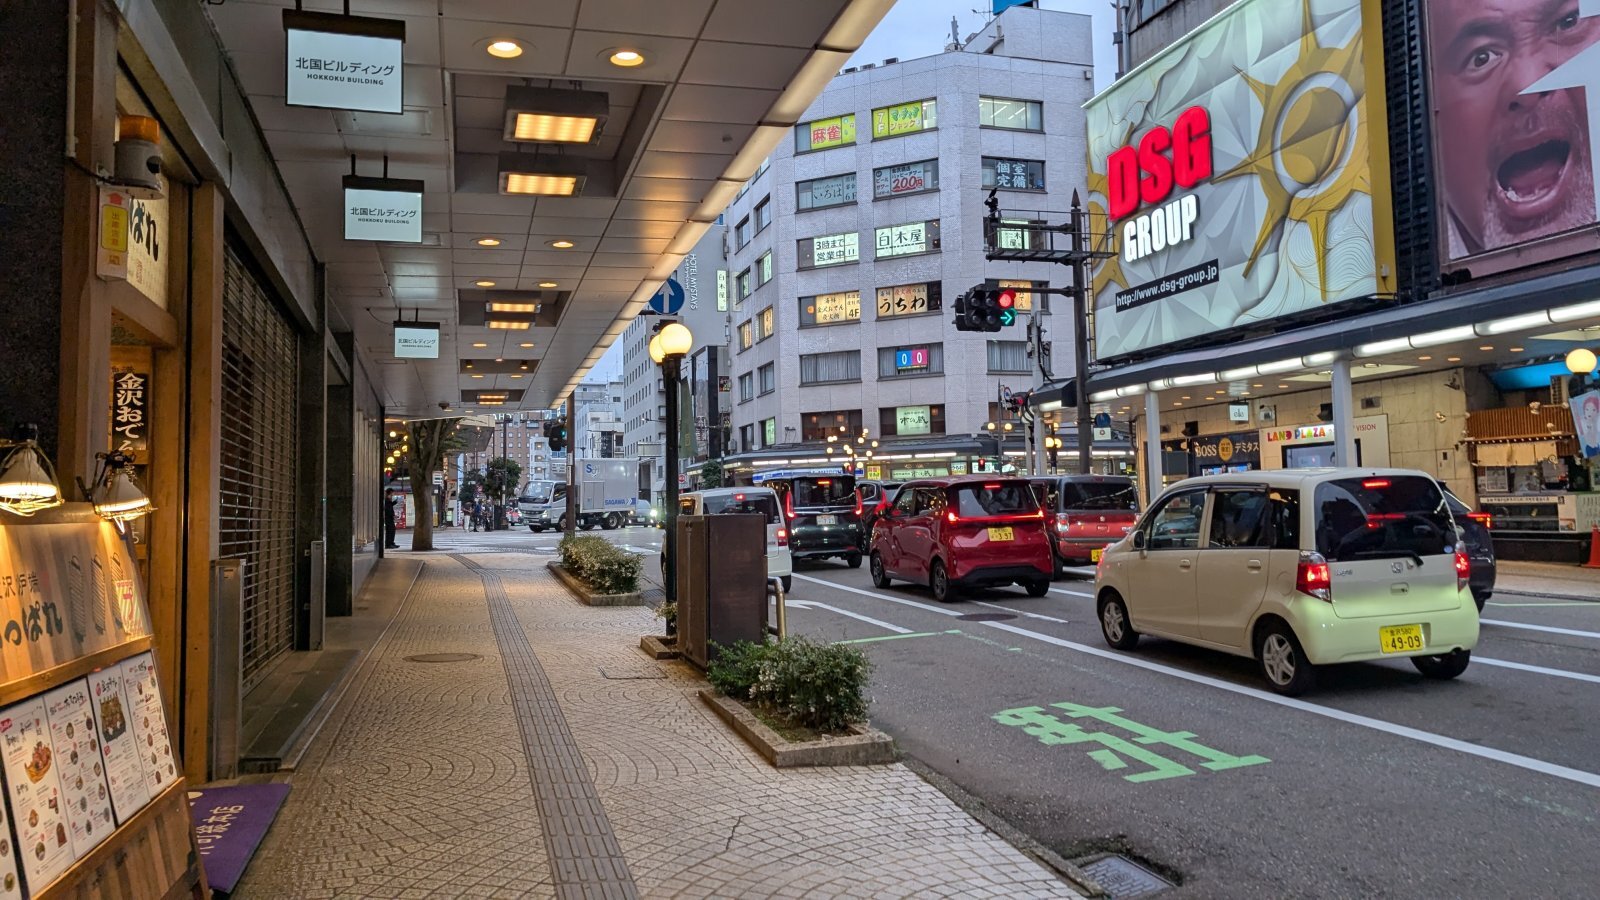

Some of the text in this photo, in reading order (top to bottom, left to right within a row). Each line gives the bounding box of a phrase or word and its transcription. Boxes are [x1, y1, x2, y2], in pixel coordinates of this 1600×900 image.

[295, 57, 395, 76] 北国ビルディング
[306, 73, 384, 85] HOKKOKU BUILDING
[813, 126, 841, 144] 麻雀
[997, 161, 1026, 175] 個室
[1106, 105, 1213, 221] DSG
[350, 207, 417, 218] 北国ビルディング
[1123, 194, 1198, 263] GROUP
[816, 239, 844, 250] 3時まで
[879, 229, 922, 247] 白木屋
[690, 276, 698, 310] MYSTAYS
[1116, 264, 1218, 307] http://www.dsg-group.jp
[880, 296, 926, 314] うちわ
[848, 308, 860, 318] 4F
[1267, 427, 1326, 442] LAND PLAZA
[1356, 423, 1377, 432] VISION
[1234, 441, 1260, 454] デミタス
[1391, 635, 1421, 650] 49-09
